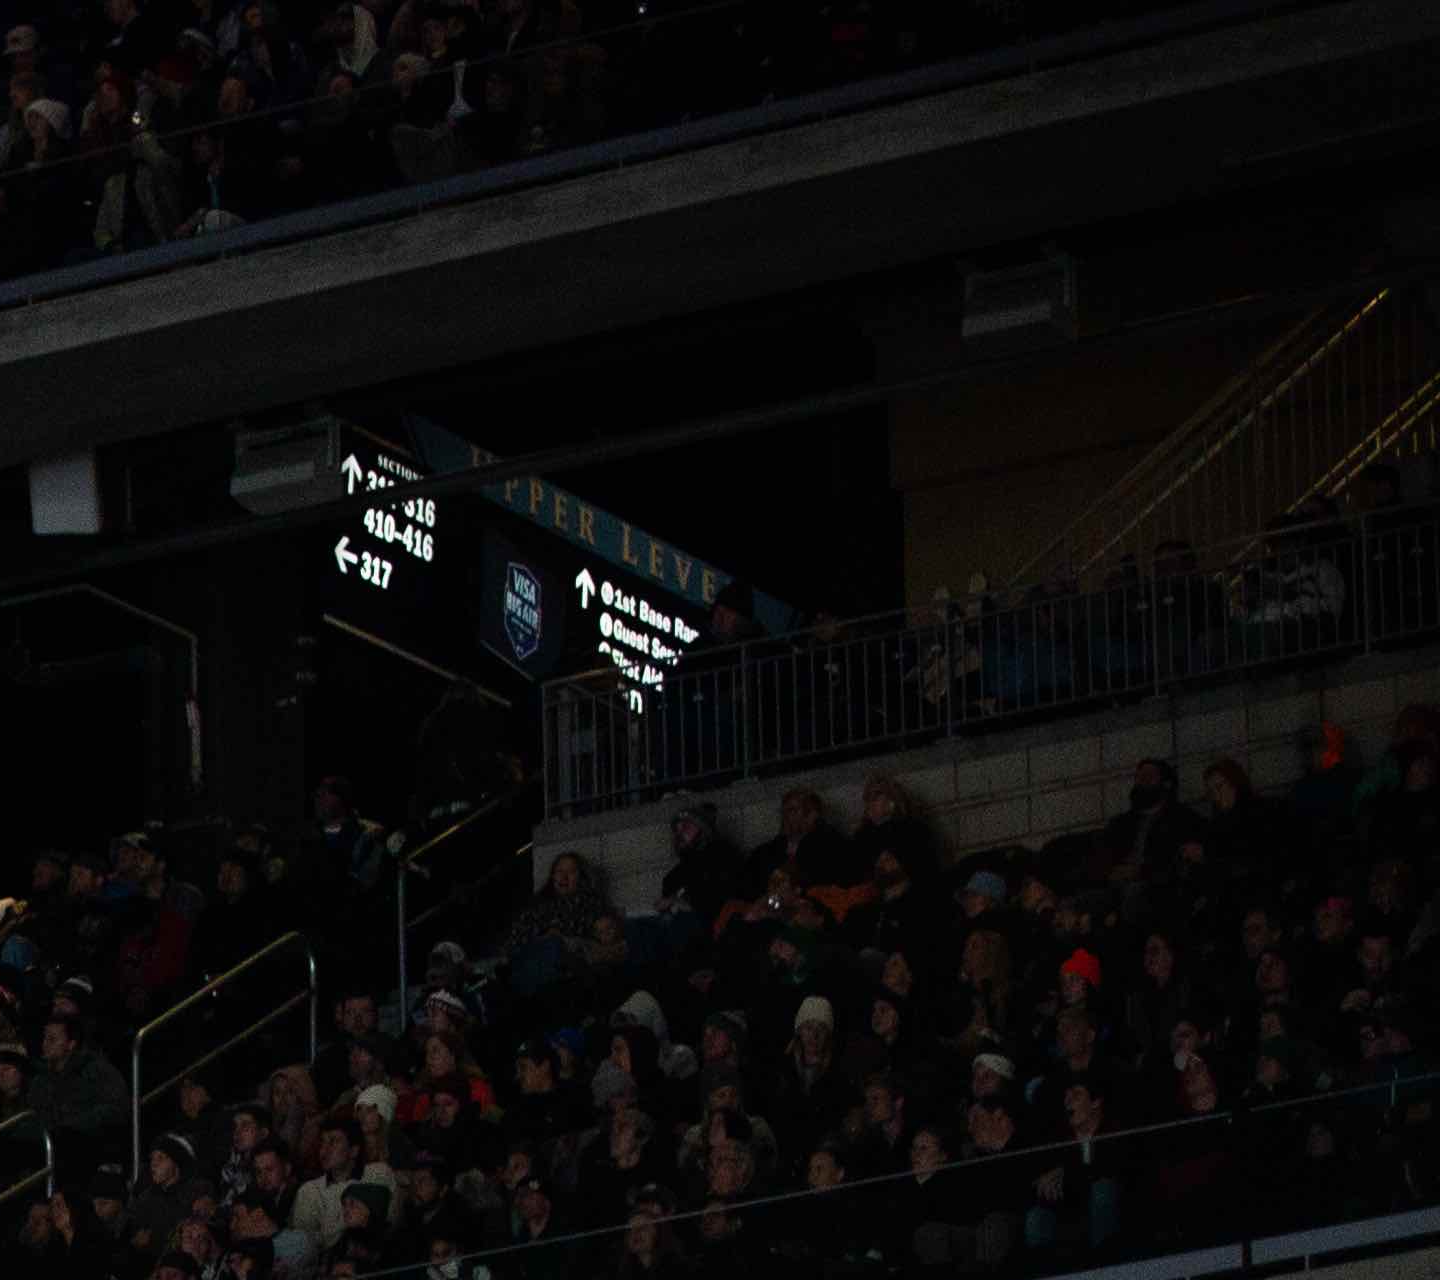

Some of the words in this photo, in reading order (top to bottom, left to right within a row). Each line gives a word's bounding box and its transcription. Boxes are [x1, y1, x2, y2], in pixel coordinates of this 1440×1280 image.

[377, 453, 425, 481] SECTION
[363, 507, 434, 563] 410-416
[360, 551, 393, 590] 317
[622, 520, 717, 605] LEVE
[513, 567, 537, 606] VISA
[639, 599, 672, 634] Base
[613, 618, 650, 656] Guest
